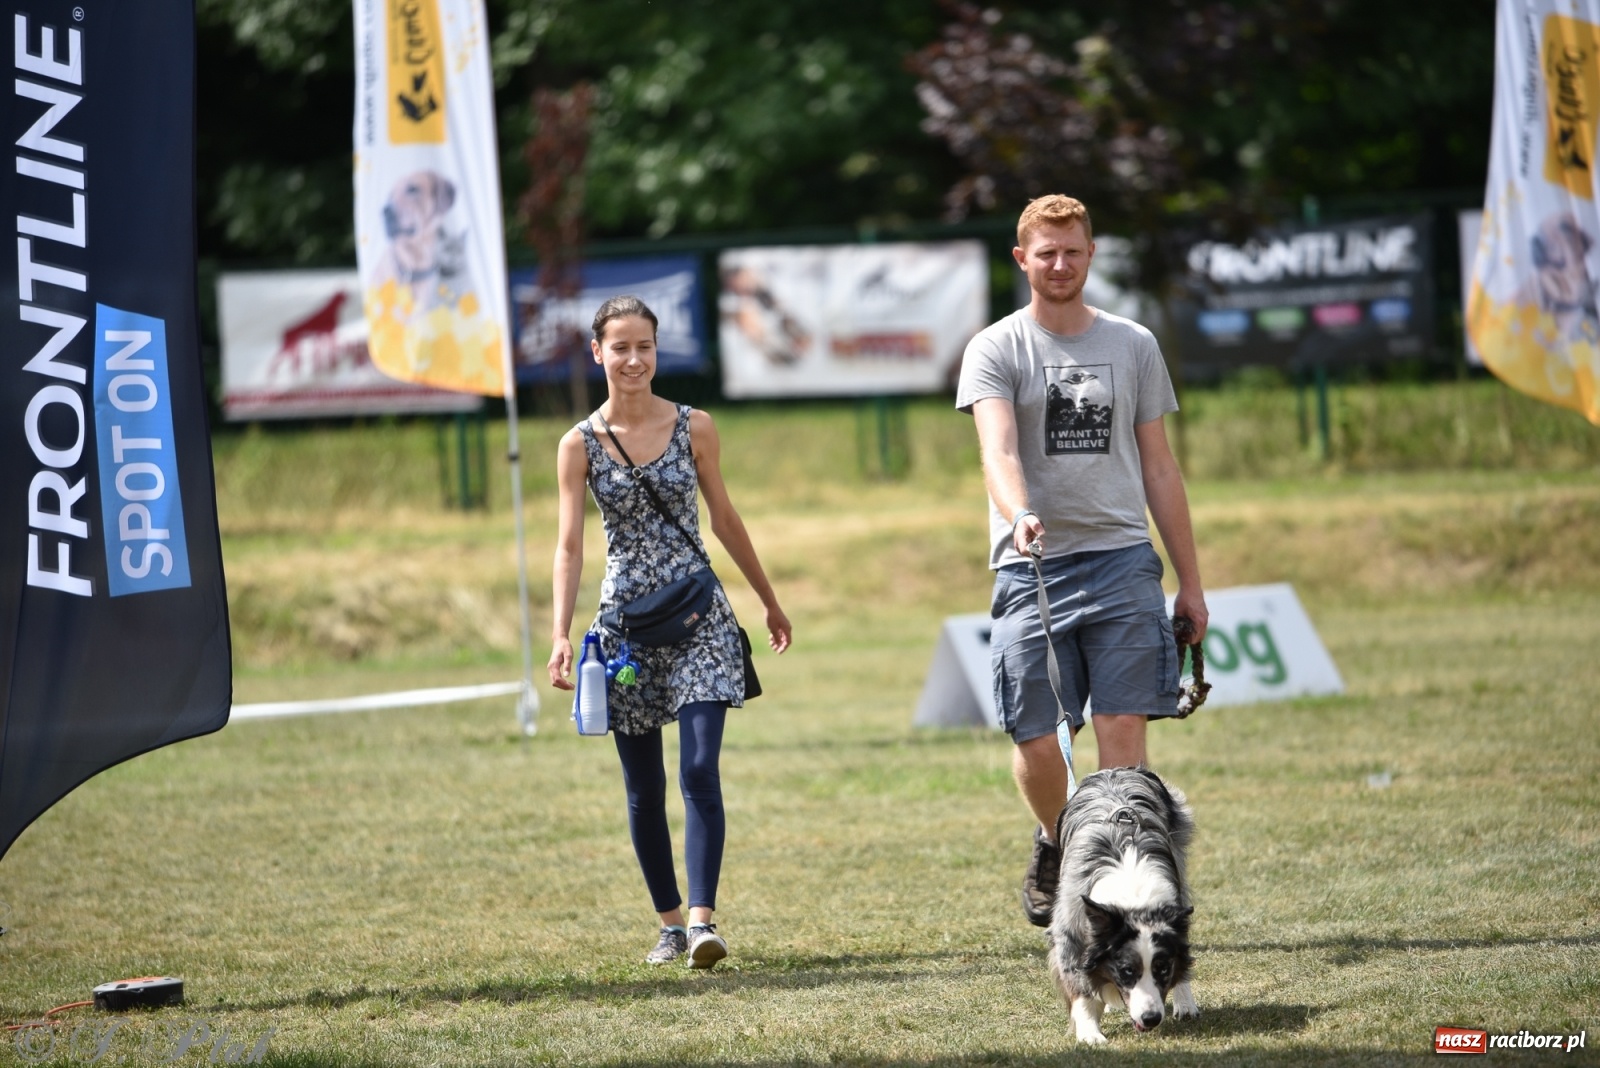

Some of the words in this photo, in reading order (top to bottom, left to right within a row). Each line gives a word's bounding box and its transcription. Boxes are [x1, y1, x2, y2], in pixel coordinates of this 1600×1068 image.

[104, 330, 158, 413] ON
[1056, 439, 1105, 449] BELIEVE
[1058, 429, 1092, 438] WANT
[1097, 428, 1110, 437] TO
[111, 424, 173, 580] SPOT
